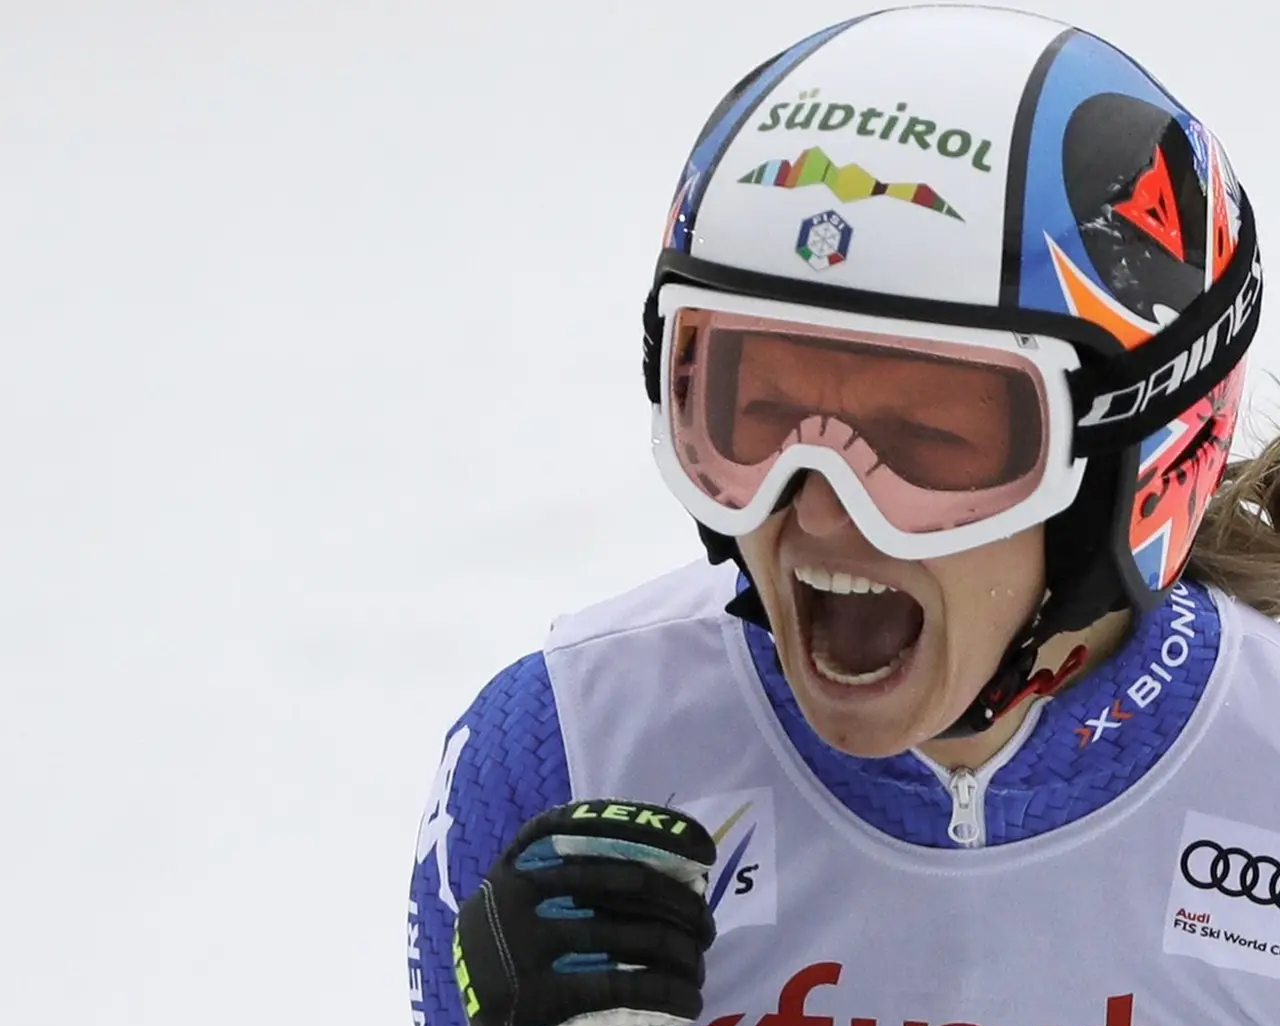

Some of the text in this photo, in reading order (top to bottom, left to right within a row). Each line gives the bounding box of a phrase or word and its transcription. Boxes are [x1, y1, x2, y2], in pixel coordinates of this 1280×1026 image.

[1078, 246, 1262, 426] DAINES
[572, 804, 687, 835] LEKI
[1175, 908, 1211, 924] Audi
[1173, 918, 1197, 934] FIS
[1200, 926, 1221, 939] Ski
[1223, 930, 1267, 952] World
